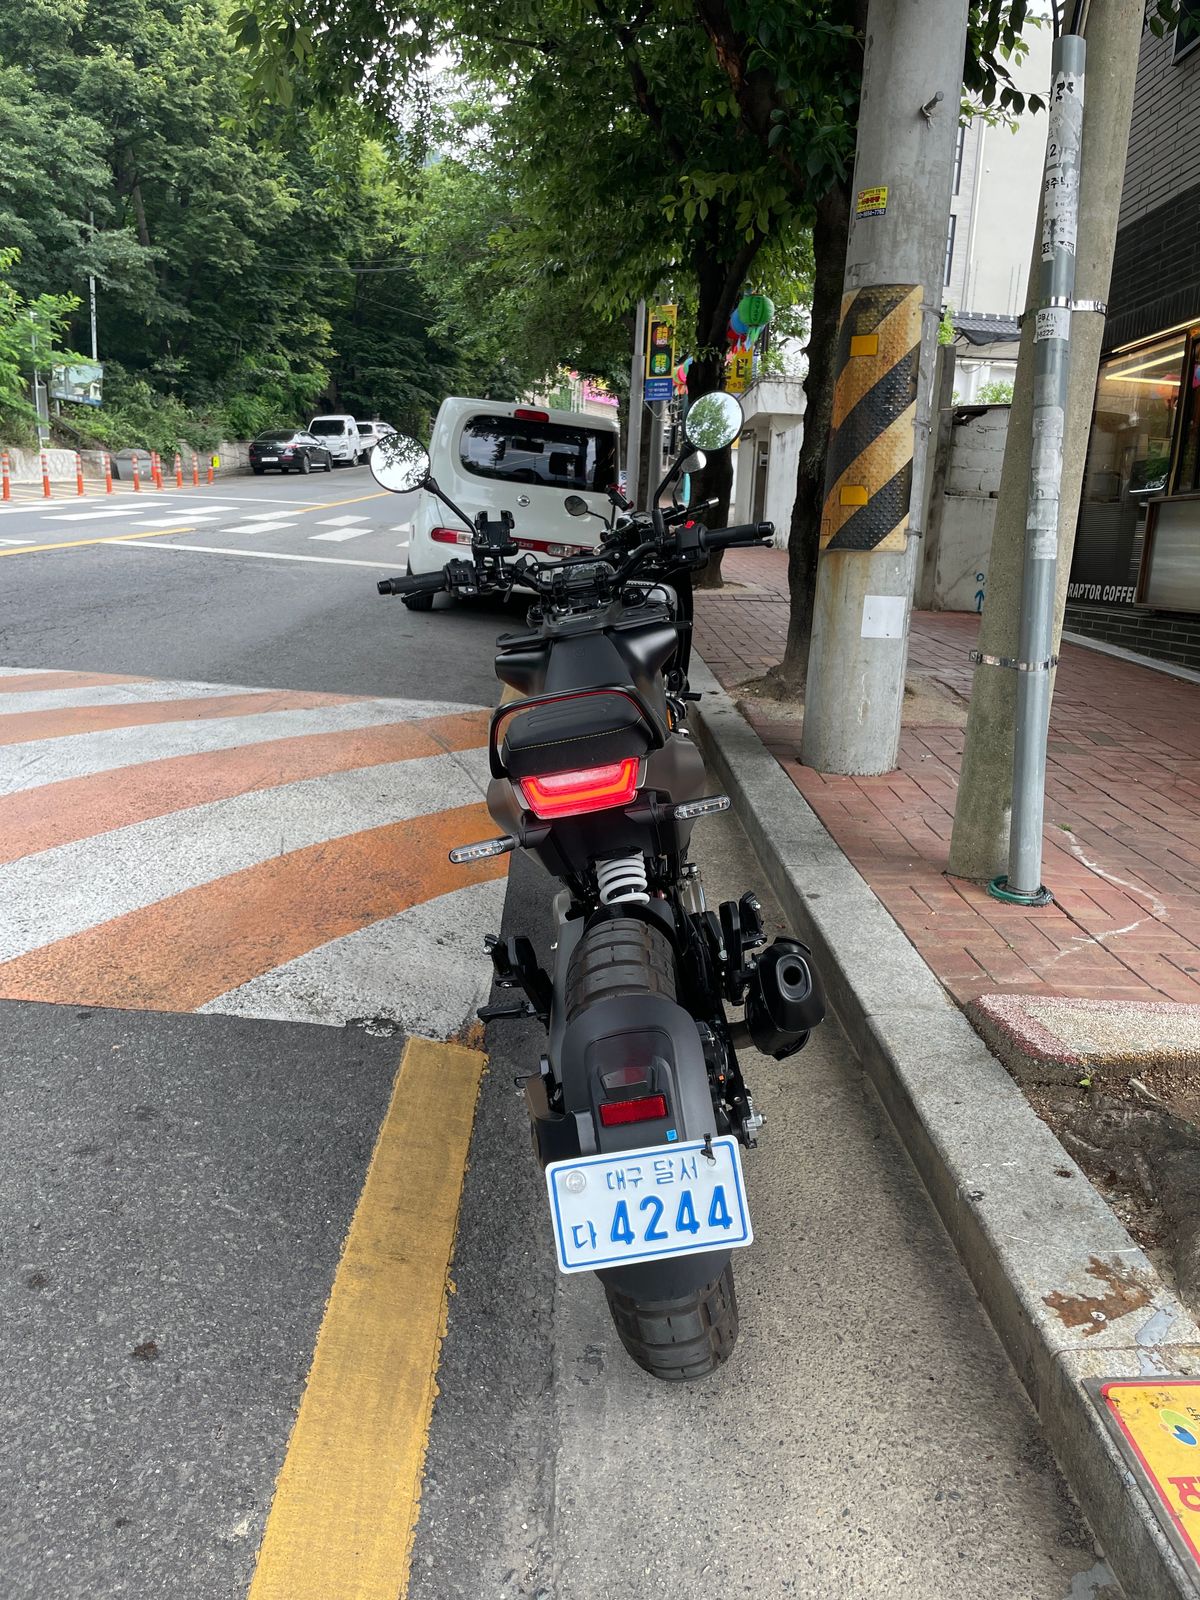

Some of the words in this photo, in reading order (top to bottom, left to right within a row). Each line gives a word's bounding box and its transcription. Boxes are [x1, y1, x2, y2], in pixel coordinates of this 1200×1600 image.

[1067, 582, 1102, 600] RAPTOR
[606, 1166, 643, 1190] 대구
[653, 1156, 698, 1185] 달서
[571, 1220, 597, 1250] 다
[610, 1185, 733, 1245] 4244
